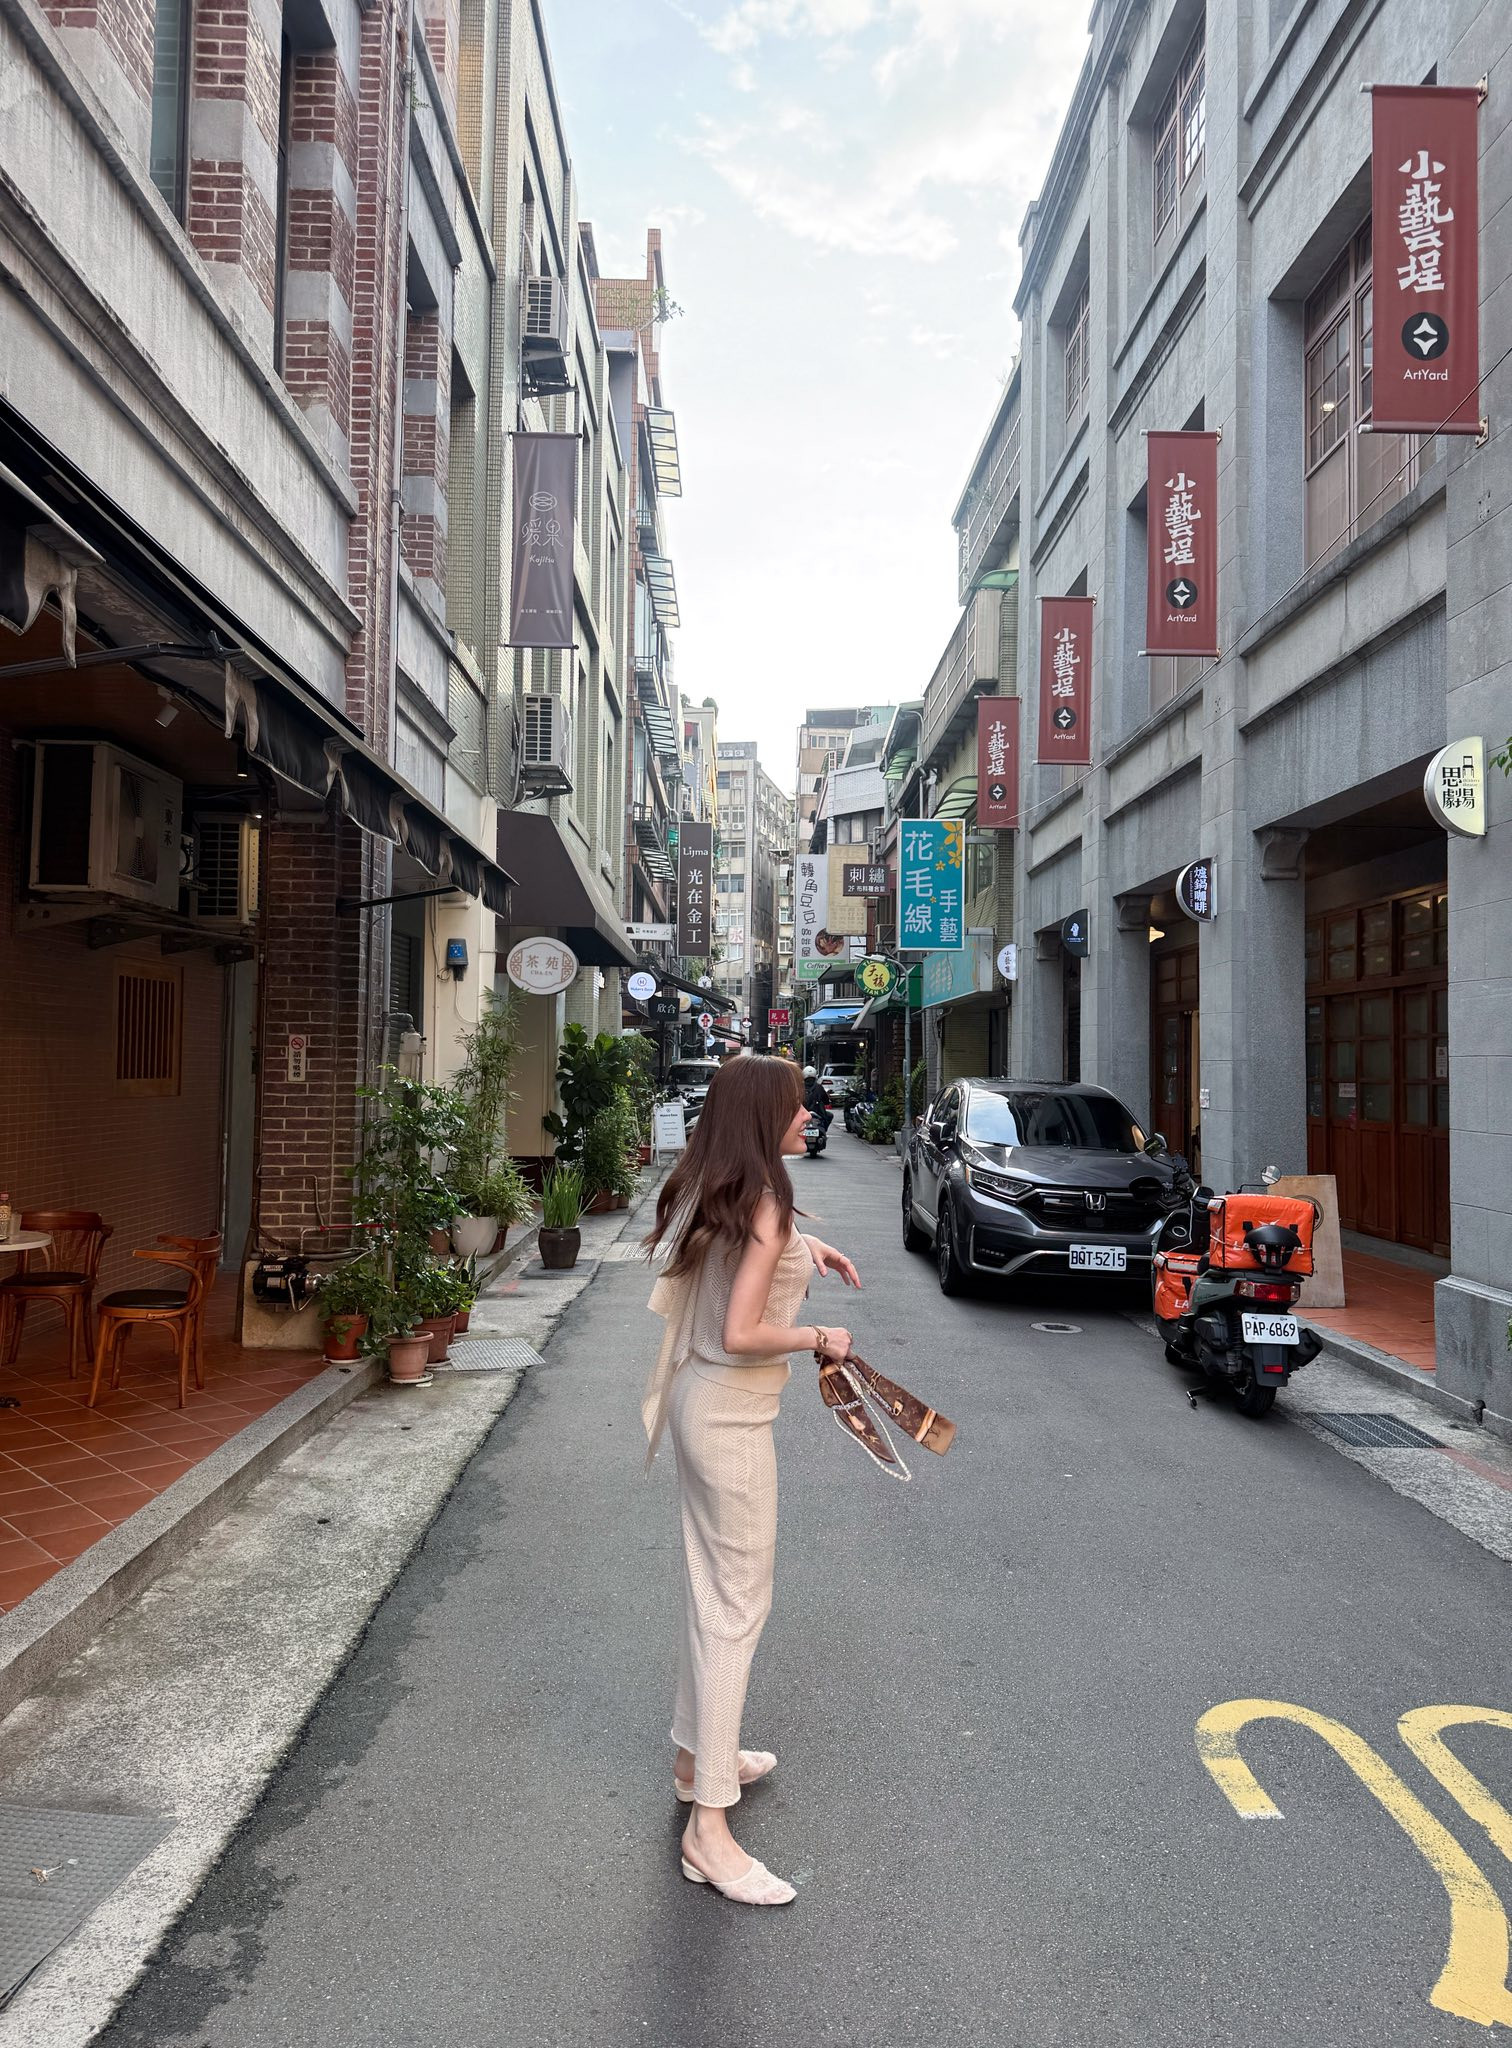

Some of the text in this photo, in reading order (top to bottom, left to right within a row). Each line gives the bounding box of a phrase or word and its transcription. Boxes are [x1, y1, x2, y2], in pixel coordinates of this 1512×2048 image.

[1397, 150, 1455, 294] 小藝埕
[1403, 368, 1448, 382] ArtYard
[1164, 472, 1202, 566] 小藝埕
[1166, 613, 1197, 623] ArtYard
[1052, 627, 1080, 698] 小藝埕
[987, 720, 1010, 777] 小藝埕
[849, 867, 885, 883] 刺繡
[904, 830, 934, 934] 花毛線
[686, 868, 704, 944] 光在金工
[939, 888, 958, 942] 手藝
[526, 955, 559, 970] 茶苑
[1070, 1250, 1125, 1267] BQT-5215
[1244, 1321, 1296, 1337] PAP-6869
